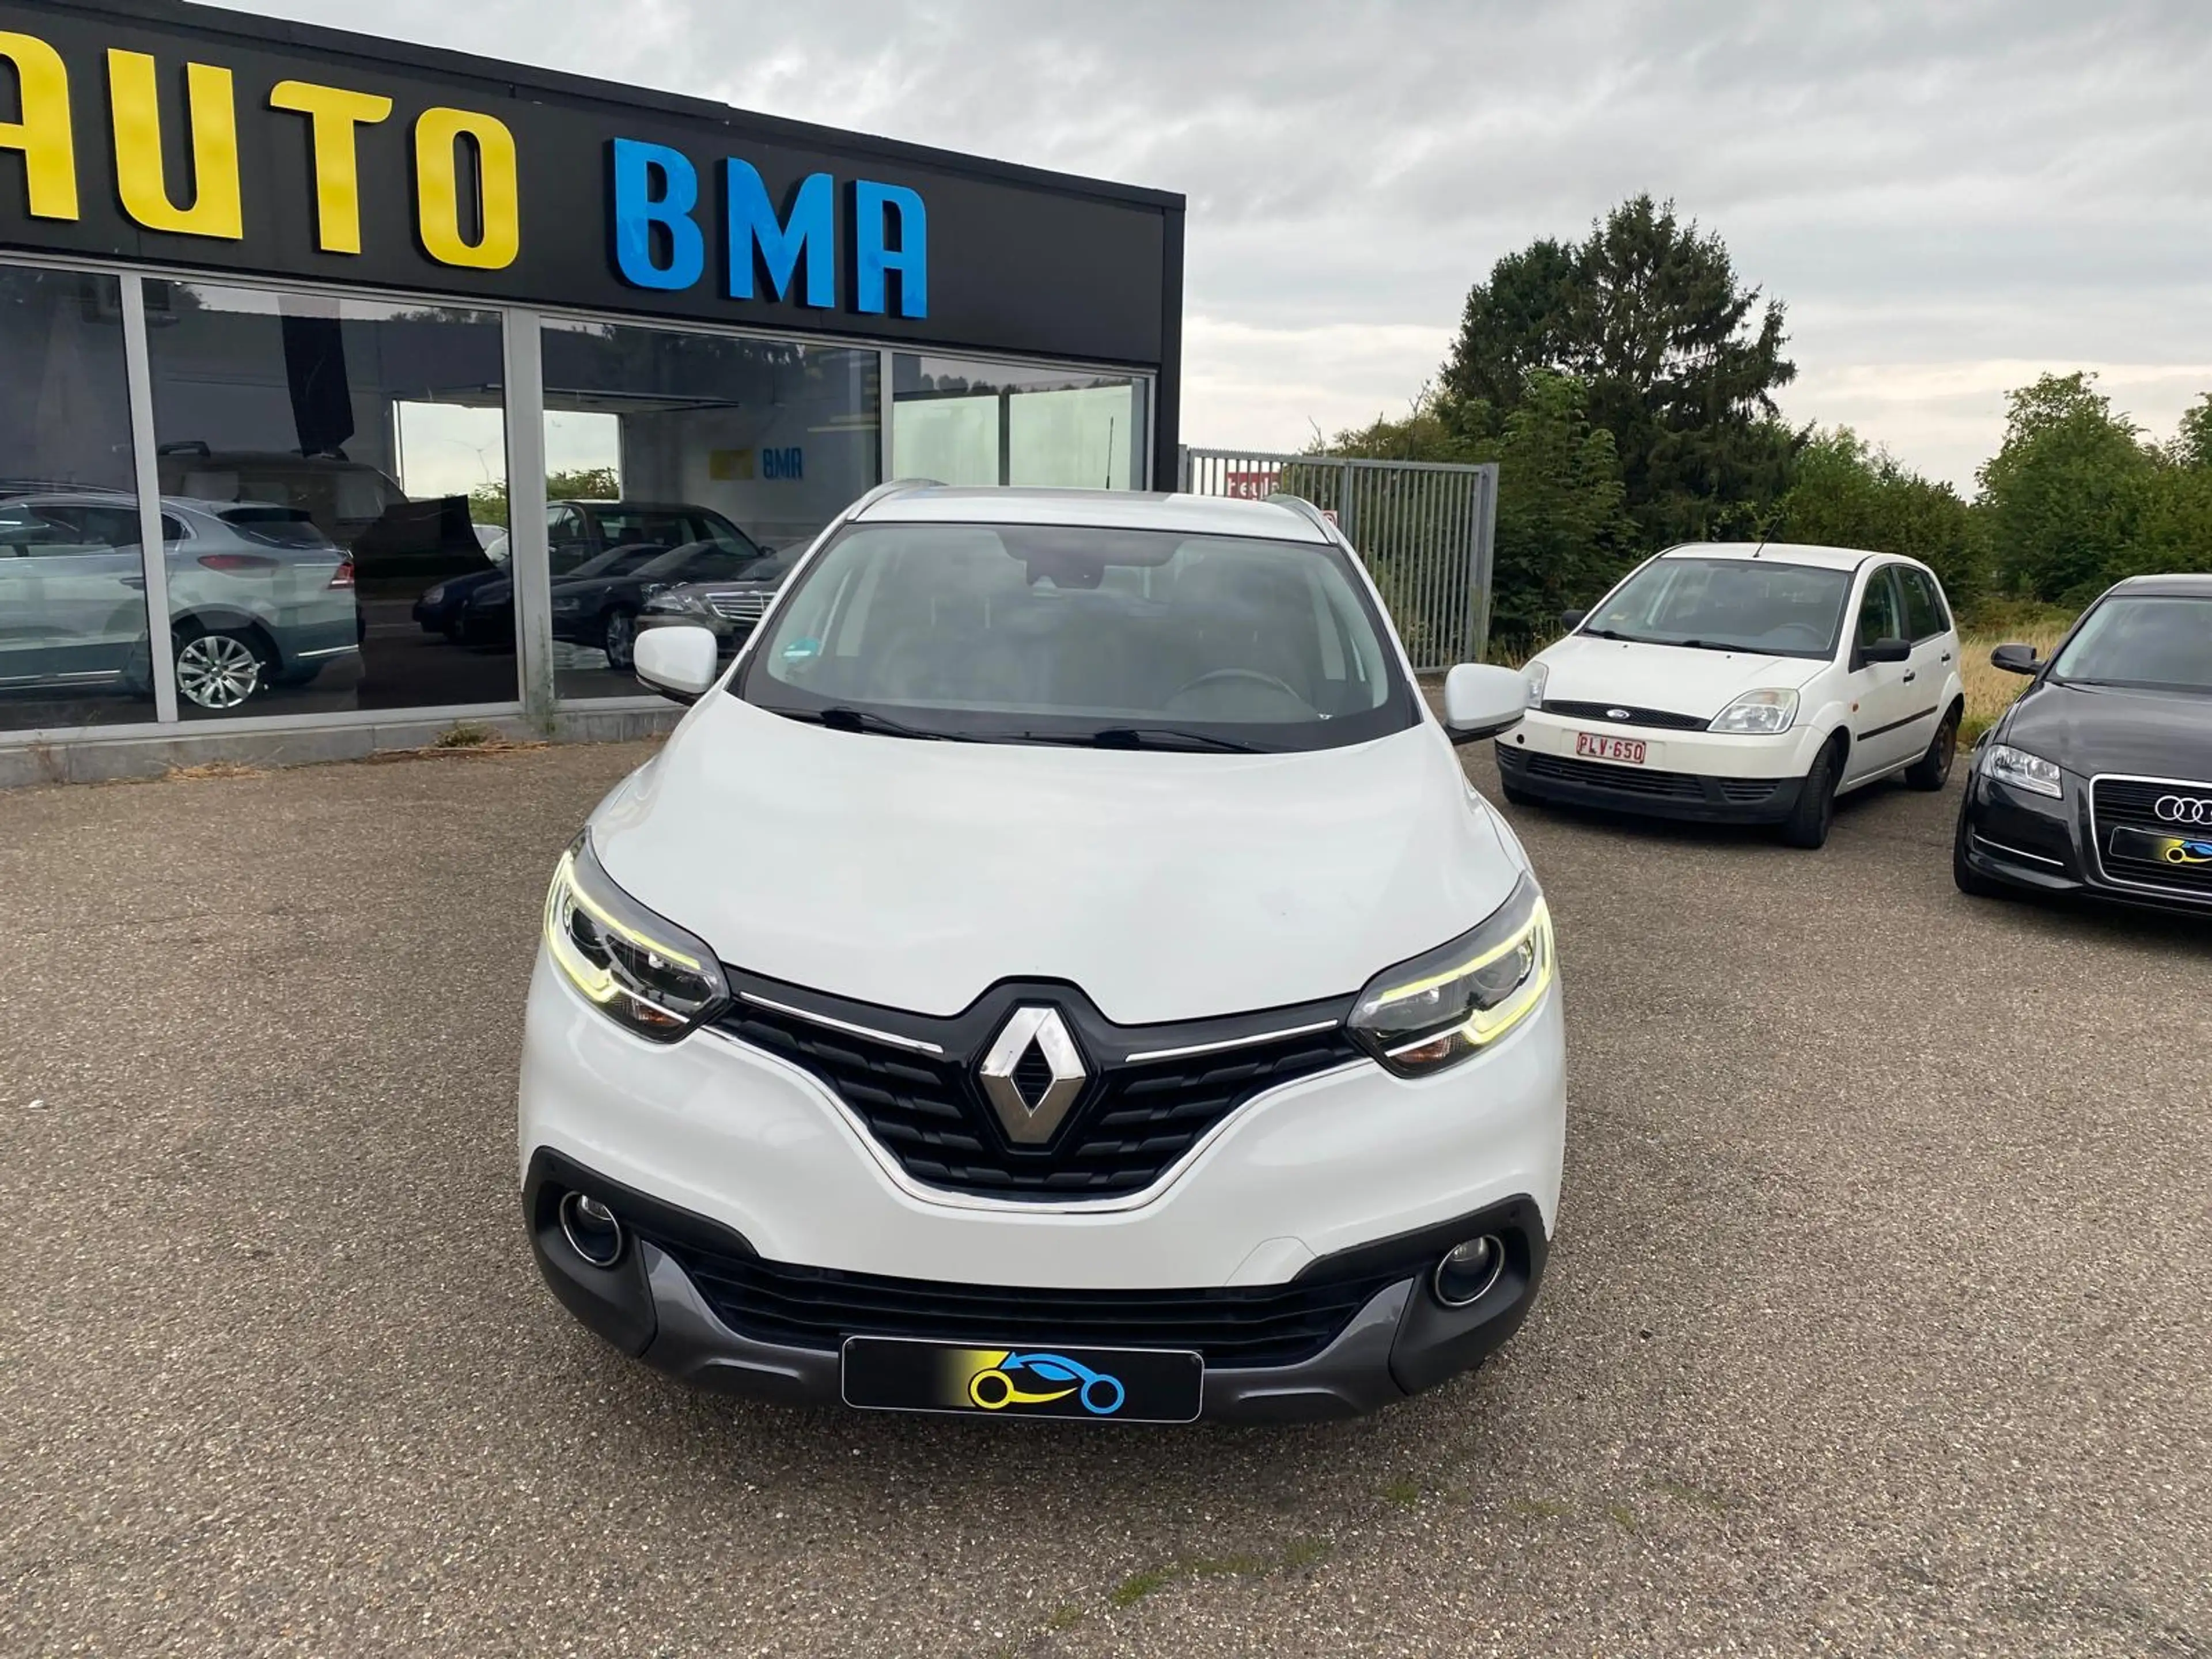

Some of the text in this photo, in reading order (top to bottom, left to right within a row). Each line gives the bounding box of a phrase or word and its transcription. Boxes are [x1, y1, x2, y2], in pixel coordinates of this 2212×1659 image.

[0, 31, 927, 319] AUTO BMA
[762, 447, 803, 480] BMA
